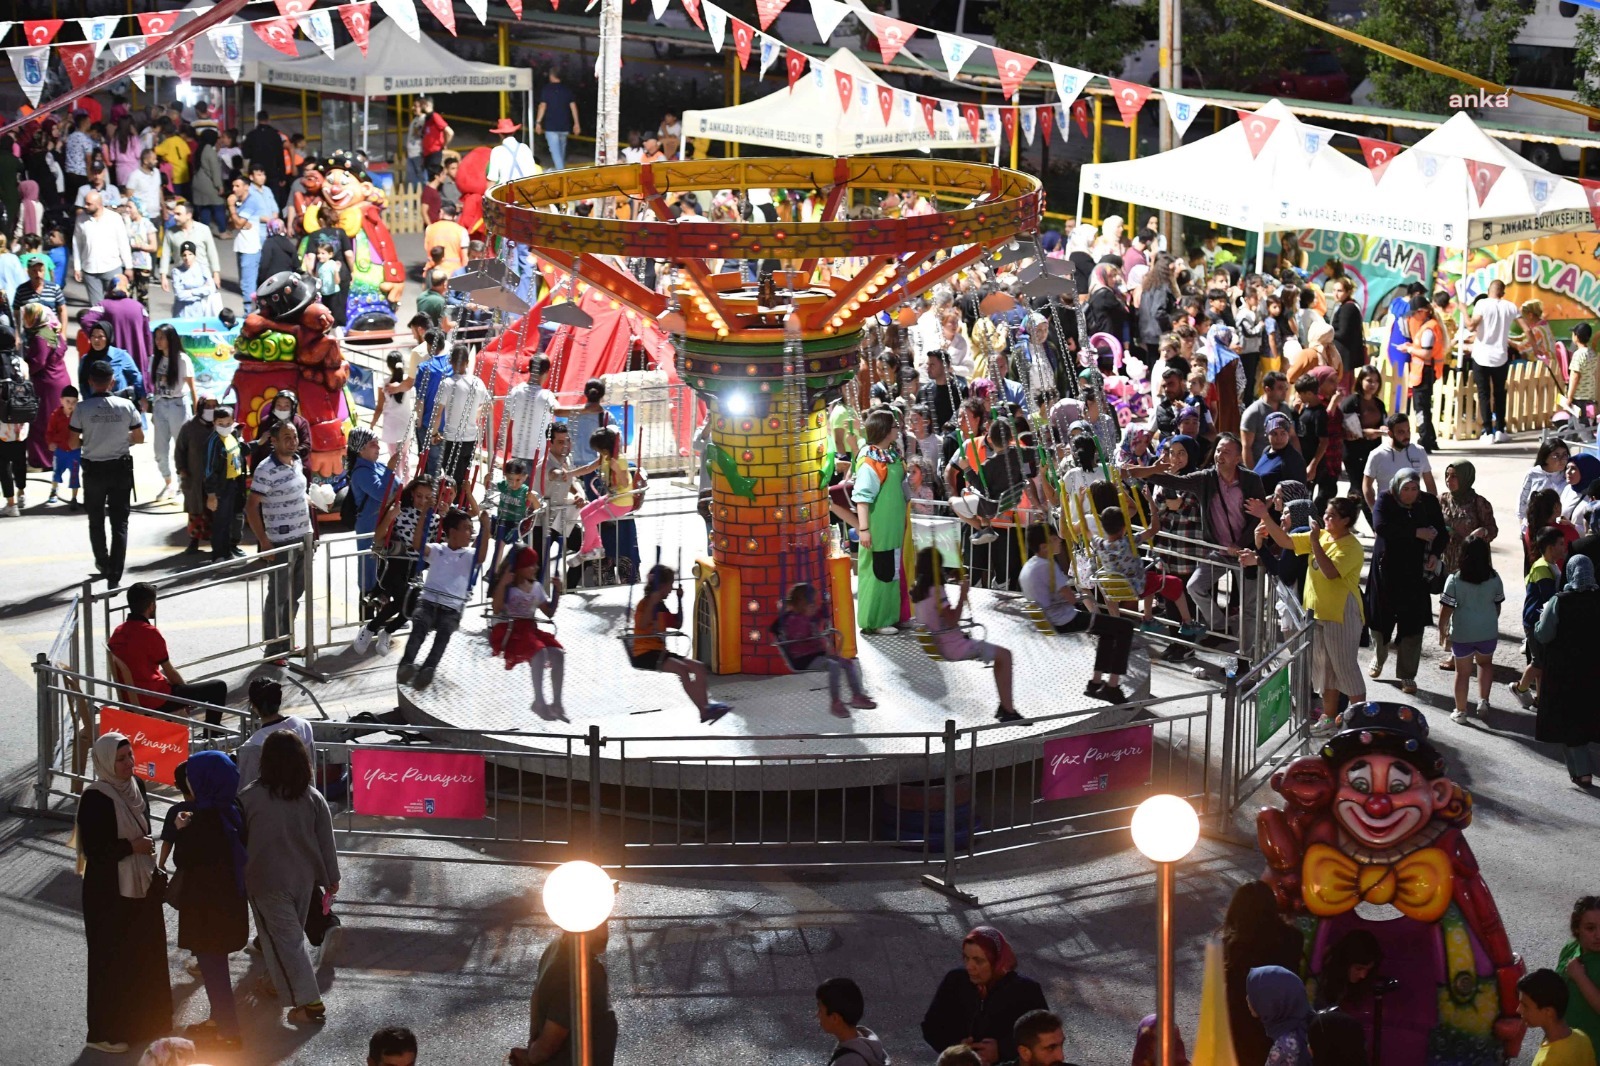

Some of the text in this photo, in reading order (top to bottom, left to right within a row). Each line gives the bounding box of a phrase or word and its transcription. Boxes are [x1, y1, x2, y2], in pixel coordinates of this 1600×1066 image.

[395, 78, 423, 88] ANKARA
[709, 122, 734, 134] ANKARA
[866, 133, 893, 145] ANKARA
[1500, 218, 1533, 236] ANKARA
[1534, 209, 1583, 230] BÜYÜKŞEHİR
[1320, 232, 1427, 283] BOYAMA
[1050, 752, 1081, 776] Yaz
[363, 766, 476, 790] Yaz Panayırı
